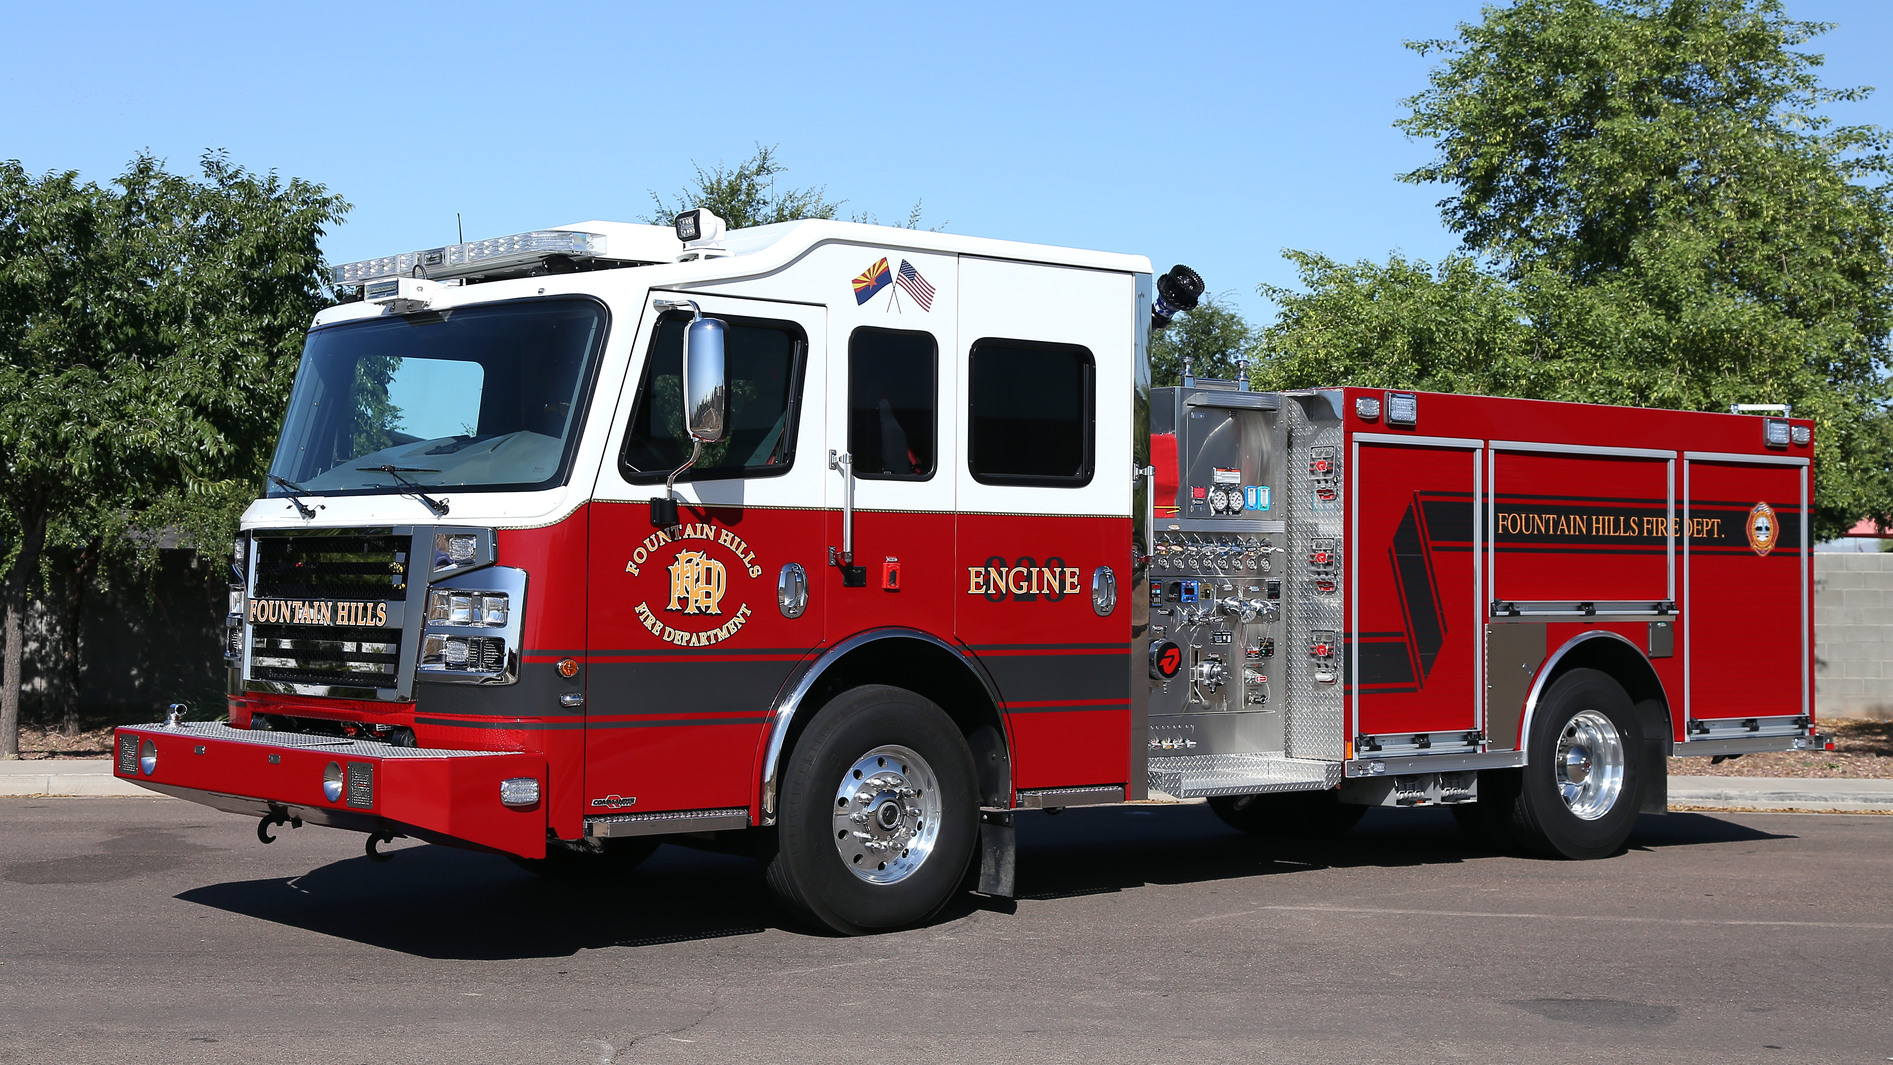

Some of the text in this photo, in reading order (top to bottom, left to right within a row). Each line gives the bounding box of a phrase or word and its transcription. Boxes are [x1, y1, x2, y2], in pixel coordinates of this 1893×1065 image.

[1497, 513, 1725, 538] FOUNTAIN HILLS FIRE DEPT.
[625, 523, 762, 578] FOUNTAIN HILLS
[967, 567, 1081, 594] ENGINE
[249, 600, 387, 627] FOUNTAIN HILLS
[634, 601, 752, 647] FIRE DEPARTMENT
